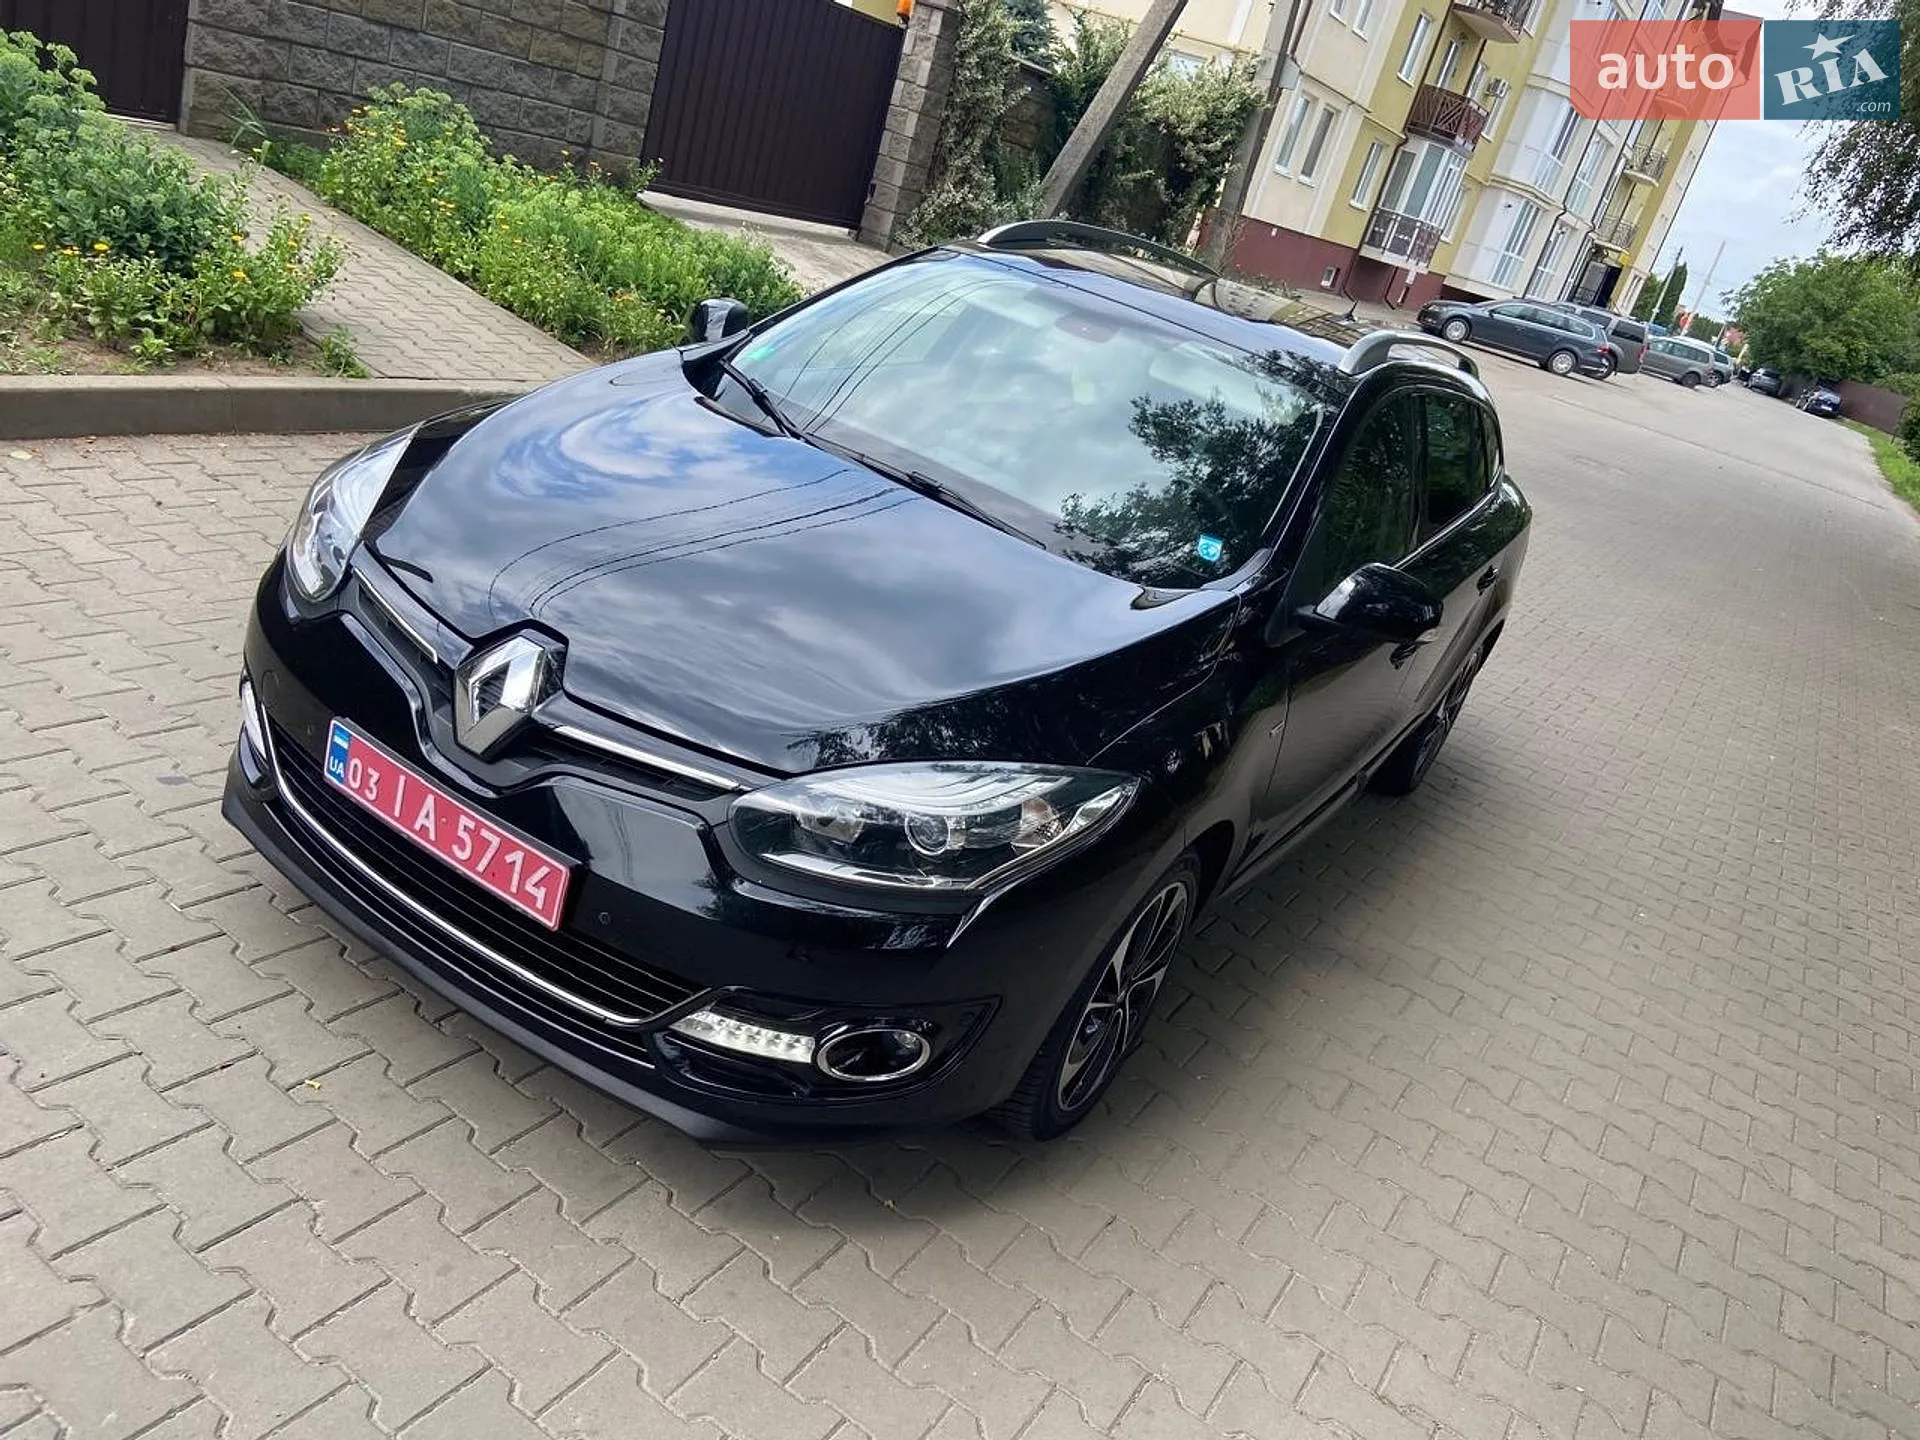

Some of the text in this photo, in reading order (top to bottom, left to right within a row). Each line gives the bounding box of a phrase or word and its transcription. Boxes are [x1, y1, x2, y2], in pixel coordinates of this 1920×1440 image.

[328, 756, 345, 778] UA
[349, 758, 380, 801] 03
[451, 814, 551, 910] 5714
